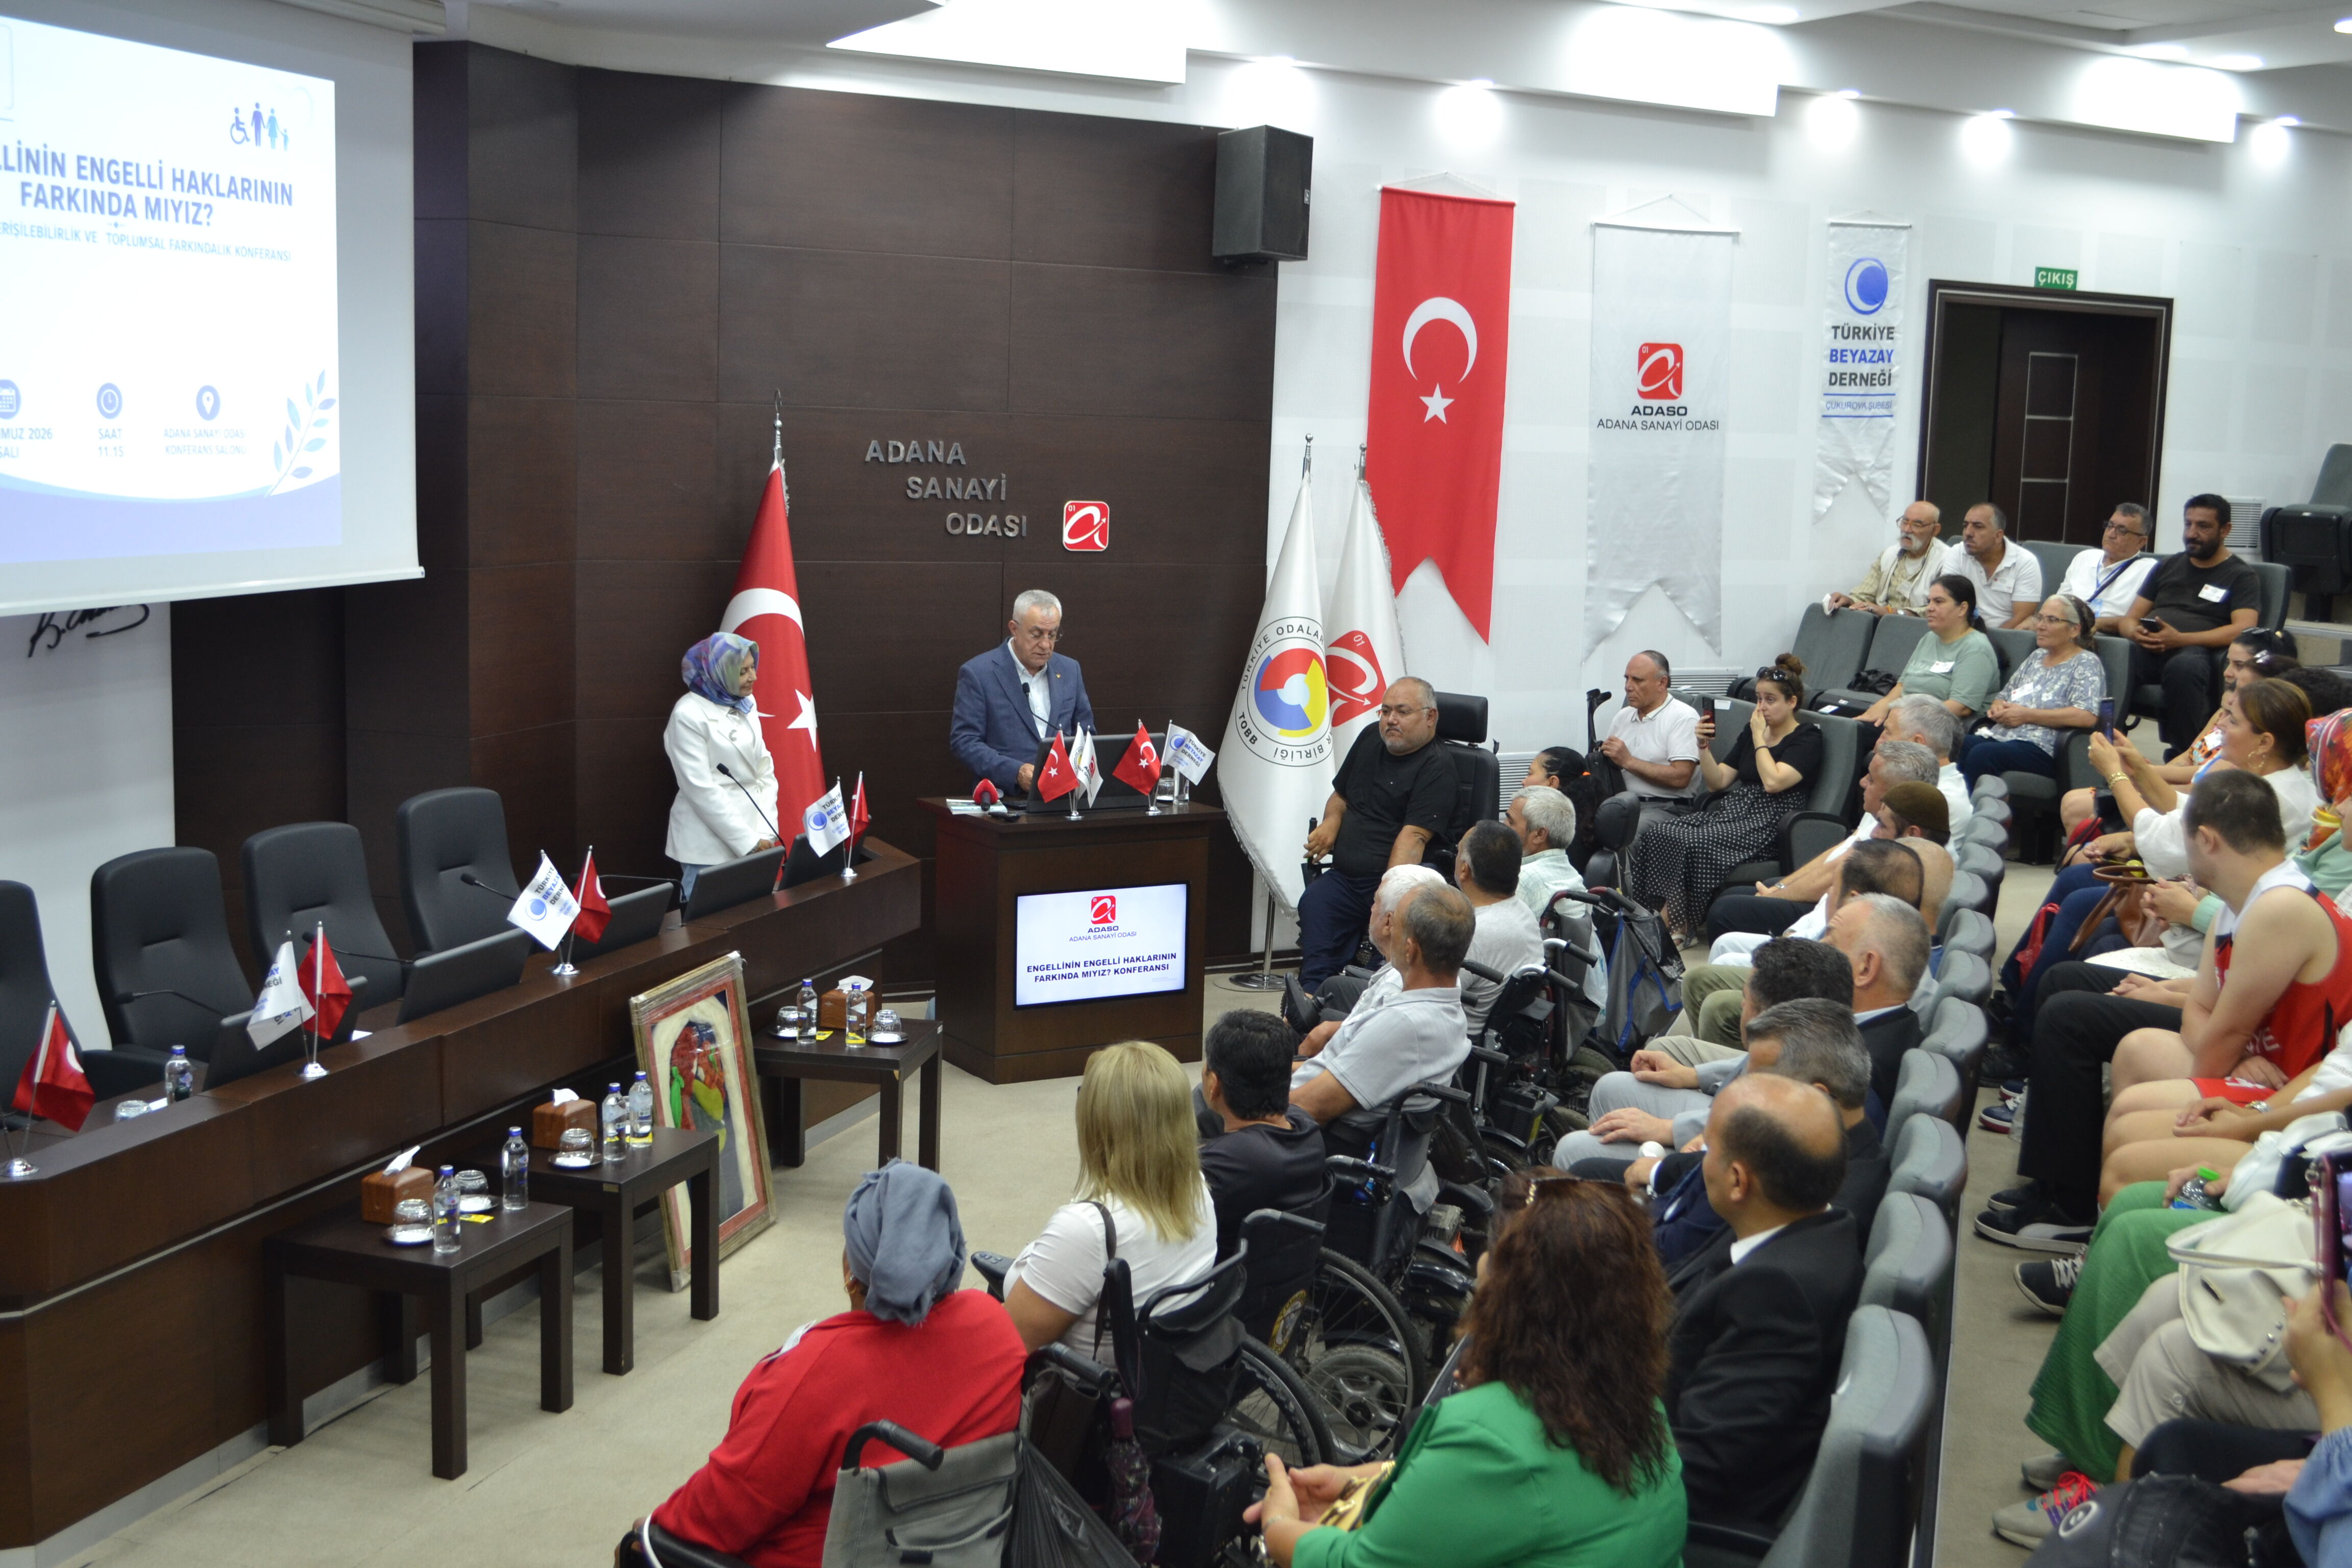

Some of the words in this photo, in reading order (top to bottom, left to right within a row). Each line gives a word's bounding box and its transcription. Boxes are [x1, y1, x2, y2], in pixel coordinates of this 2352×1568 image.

[0, 139, 66, 179] LİNİN
[77, 155, 163, 190] ENGELLİ
[172, 167, 292, 206] HAKLARININ
[21, 181, 138, 219] FARKINDA
[144, 195, 213, 227] MIYIZ?
[85, 231, 98, 243] VE
[106, 232, 166, 250] TOPLUMSAL
[169, 238, 232, 256] FARKINDALIK
[235, 246, 291, 262] KONFERANSI
[2038, 270, 2074, 289] ÇIKIŞ
[1831, 323, 1895, 341] TÜRKİYE
[1642, 346, 1649, 354] 01
[1829, 348, 1894, 364] BEYAZAY
[1828, 369, 1892, 387] DERNEĞİ
[1631, 406, 1688, 416] ADASO
[1825, 401, 1867, 410] ÇUKUROVA
[1868, 400, 1893, 411] ŞUBESİ
[0, 427, 24, 440] MUZ
[29, 428, 53, 440] 2026
[98, 428, 122, 440] SAAT
[163, 428, 191, 438] ADANA
[1597, 419, 1638, 431] ADANA
[1640, 418, 1682, 431] SANAYİ
[1685, 420, 1719, 431] ODASI
[98, 446, 124, 458] 11.15
[165, 445, 213, 455] KONFERANS
[215, 445, 246, 455] SALONU
[865, 439, 967, 465] ADANA
[906, 474, 1007, 501] SANAYİ
[945, 512, 1026, 537] ODASI
[1240, 634, 1270, 692] TÜRKİYE
[1238, 712, 1258, 745] TOBB
[1184, 743, 1204, 763] BEYAZAY
[1188, 738, 1207, 758] TÜRKİYE
[1273, 743, 1325, 762] BİRLİĞİ
[1087, 925, 1119, 934] ADASO
[1026, 960, 1081, 973] ENGELLİNİN
[1083, 956, 1120, 968] ENGELLİ
[1123, 952, 1177, 964] HAKLARININ
[1034, 972, 1079, 983] FARKINDA
[1082, 969, 1111, 978] MIYIZ?
[1114, 963, 1169, 975] KONFERANSI
